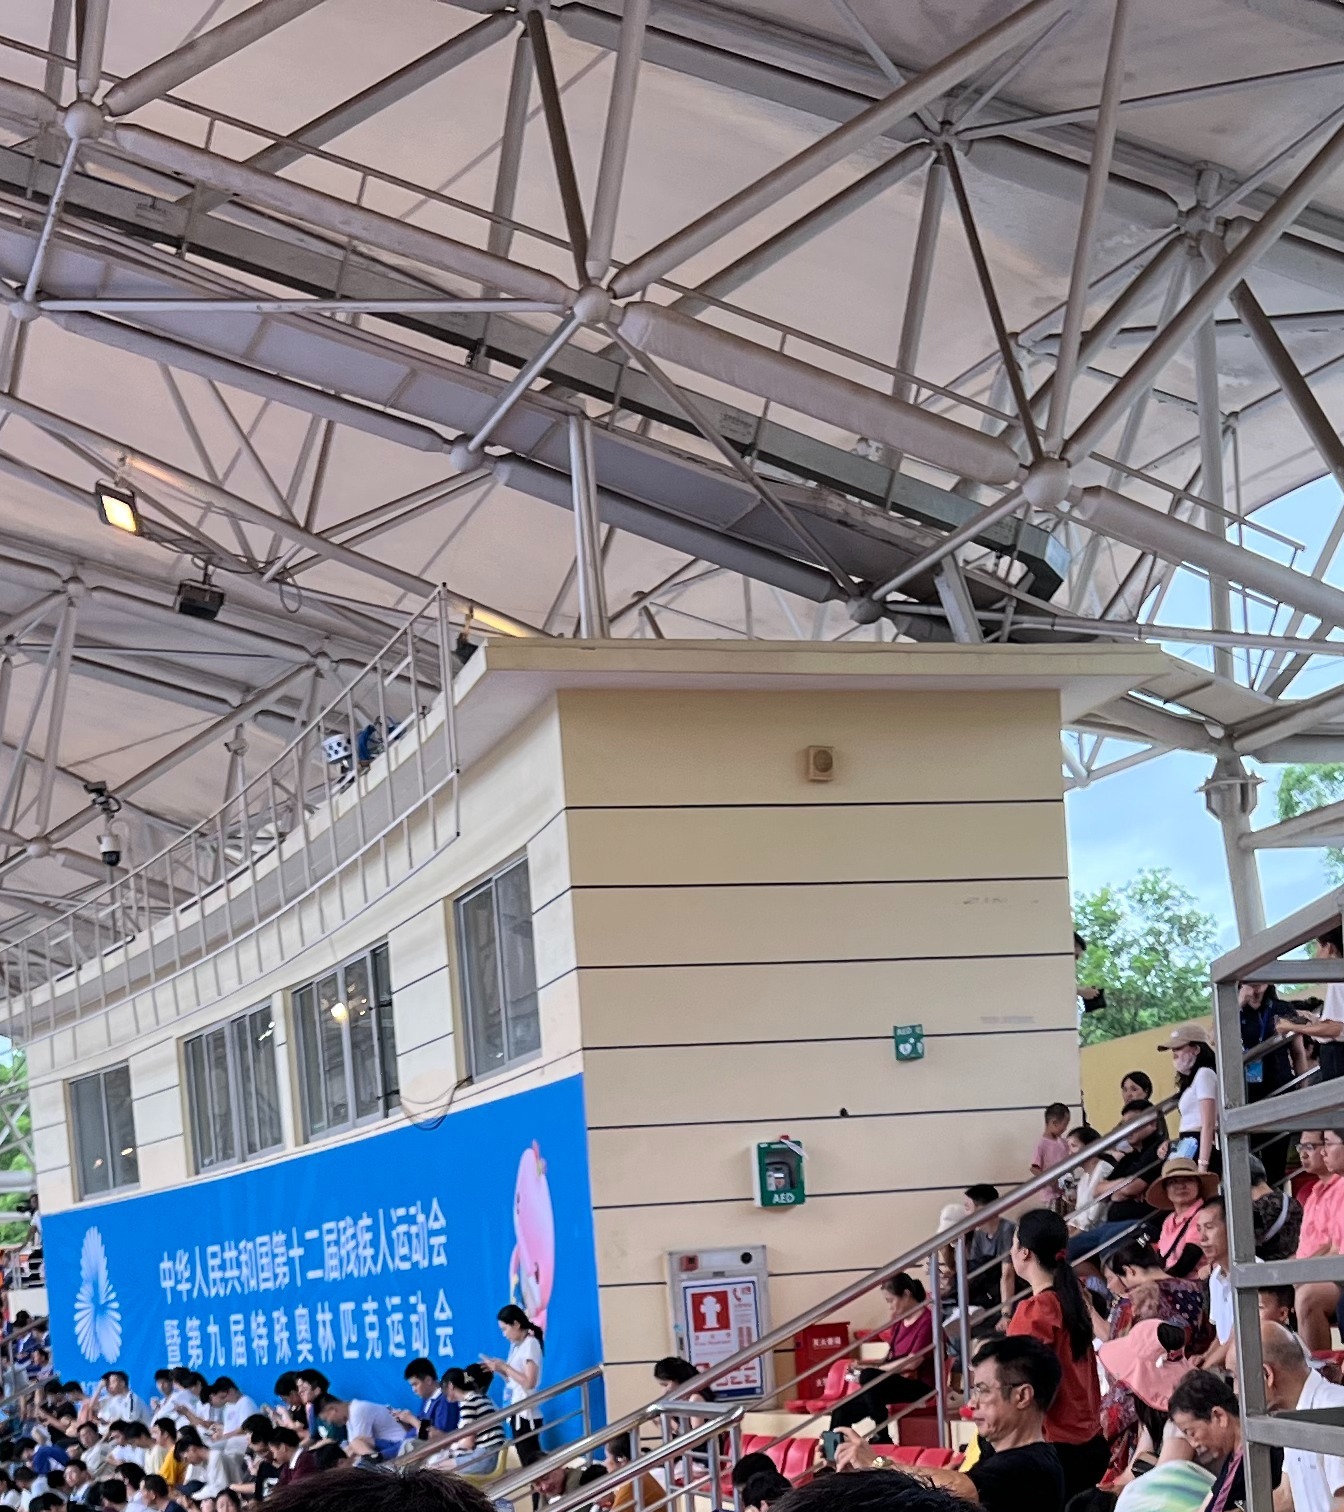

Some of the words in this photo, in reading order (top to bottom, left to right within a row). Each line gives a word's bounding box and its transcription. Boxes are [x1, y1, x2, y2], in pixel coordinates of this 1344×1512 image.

[772, 1192, 795, 1204] AED
[159, 1197, 448, 1304] 中华人民共和国第十二届残疾人运动会
[164, 1287, 454, 1370] 暨第九届特殊奥林匹克运动会
